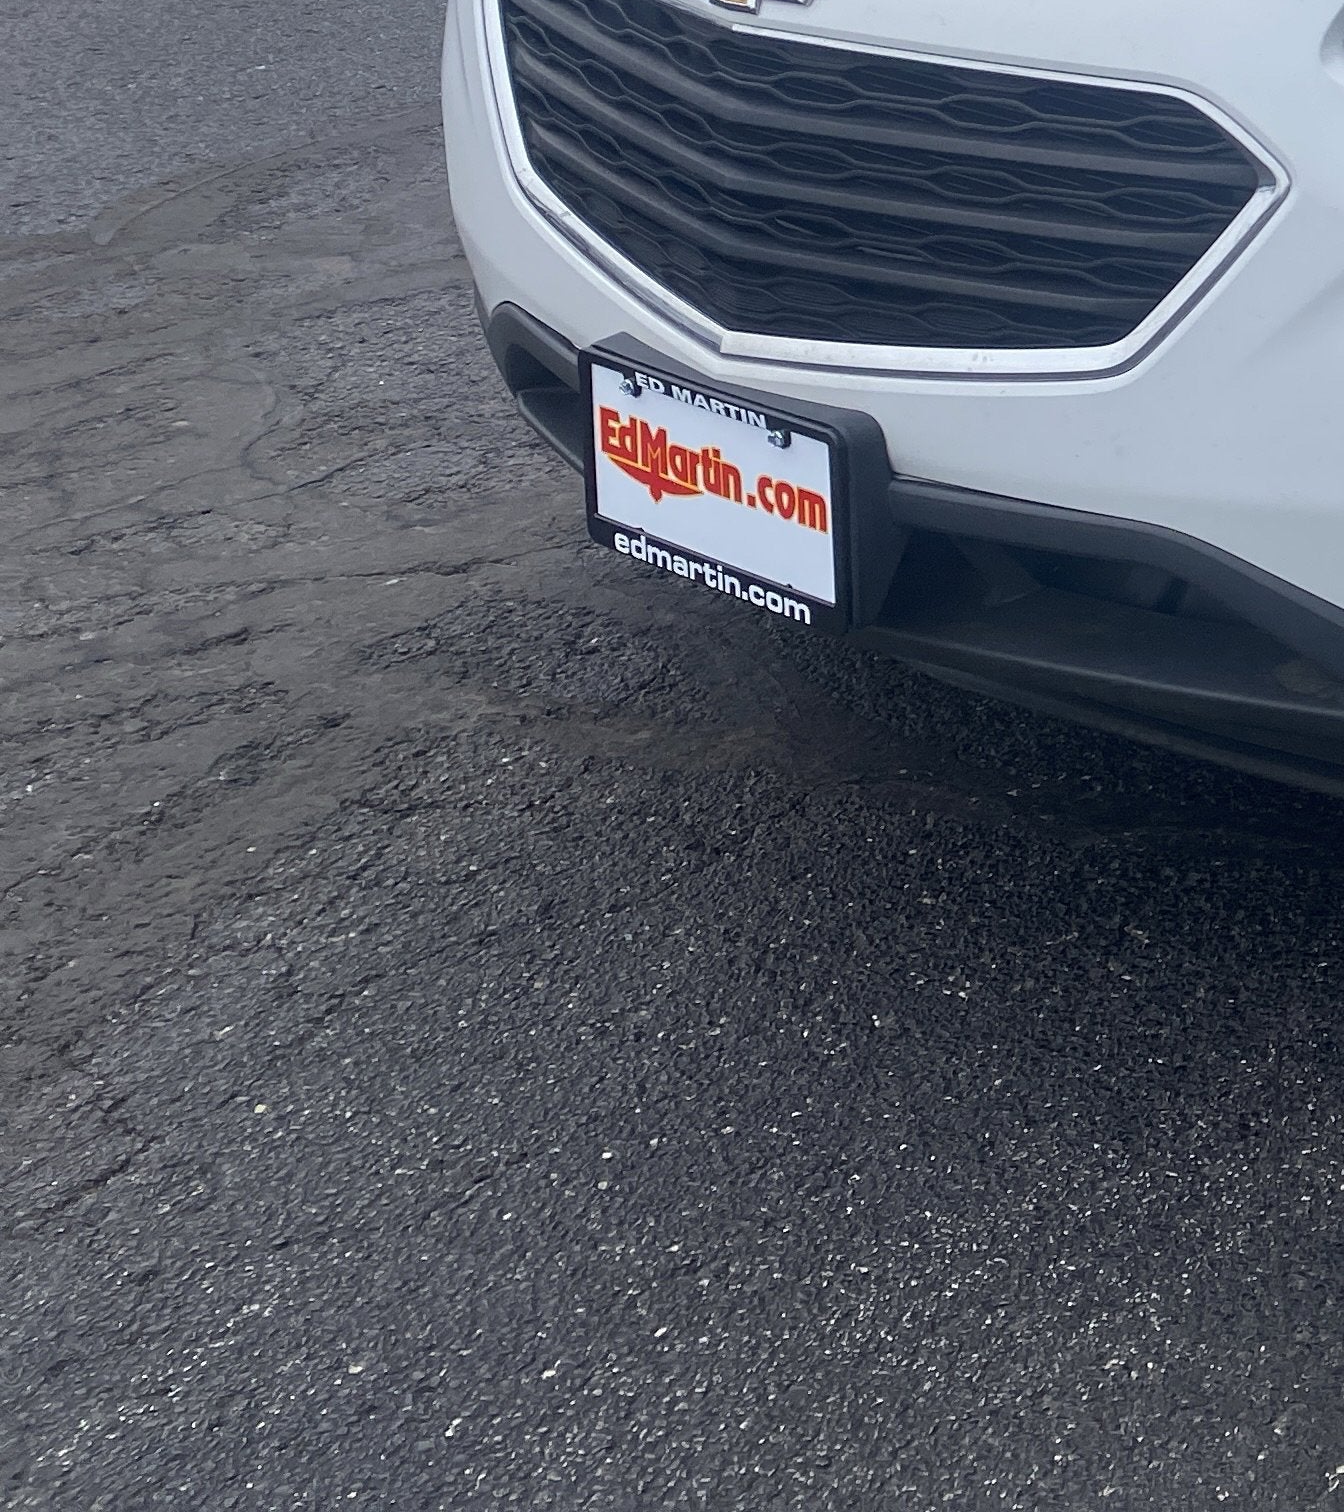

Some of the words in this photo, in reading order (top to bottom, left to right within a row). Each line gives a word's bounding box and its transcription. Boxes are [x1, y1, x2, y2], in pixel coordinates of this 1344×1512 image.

[635, 371, 665, 396] ED
[672, 386, 767, 429] MARTIN
[599, 405, 828, 534] EdMartin.com
[614, 531, 811, 625] edmartin.com
